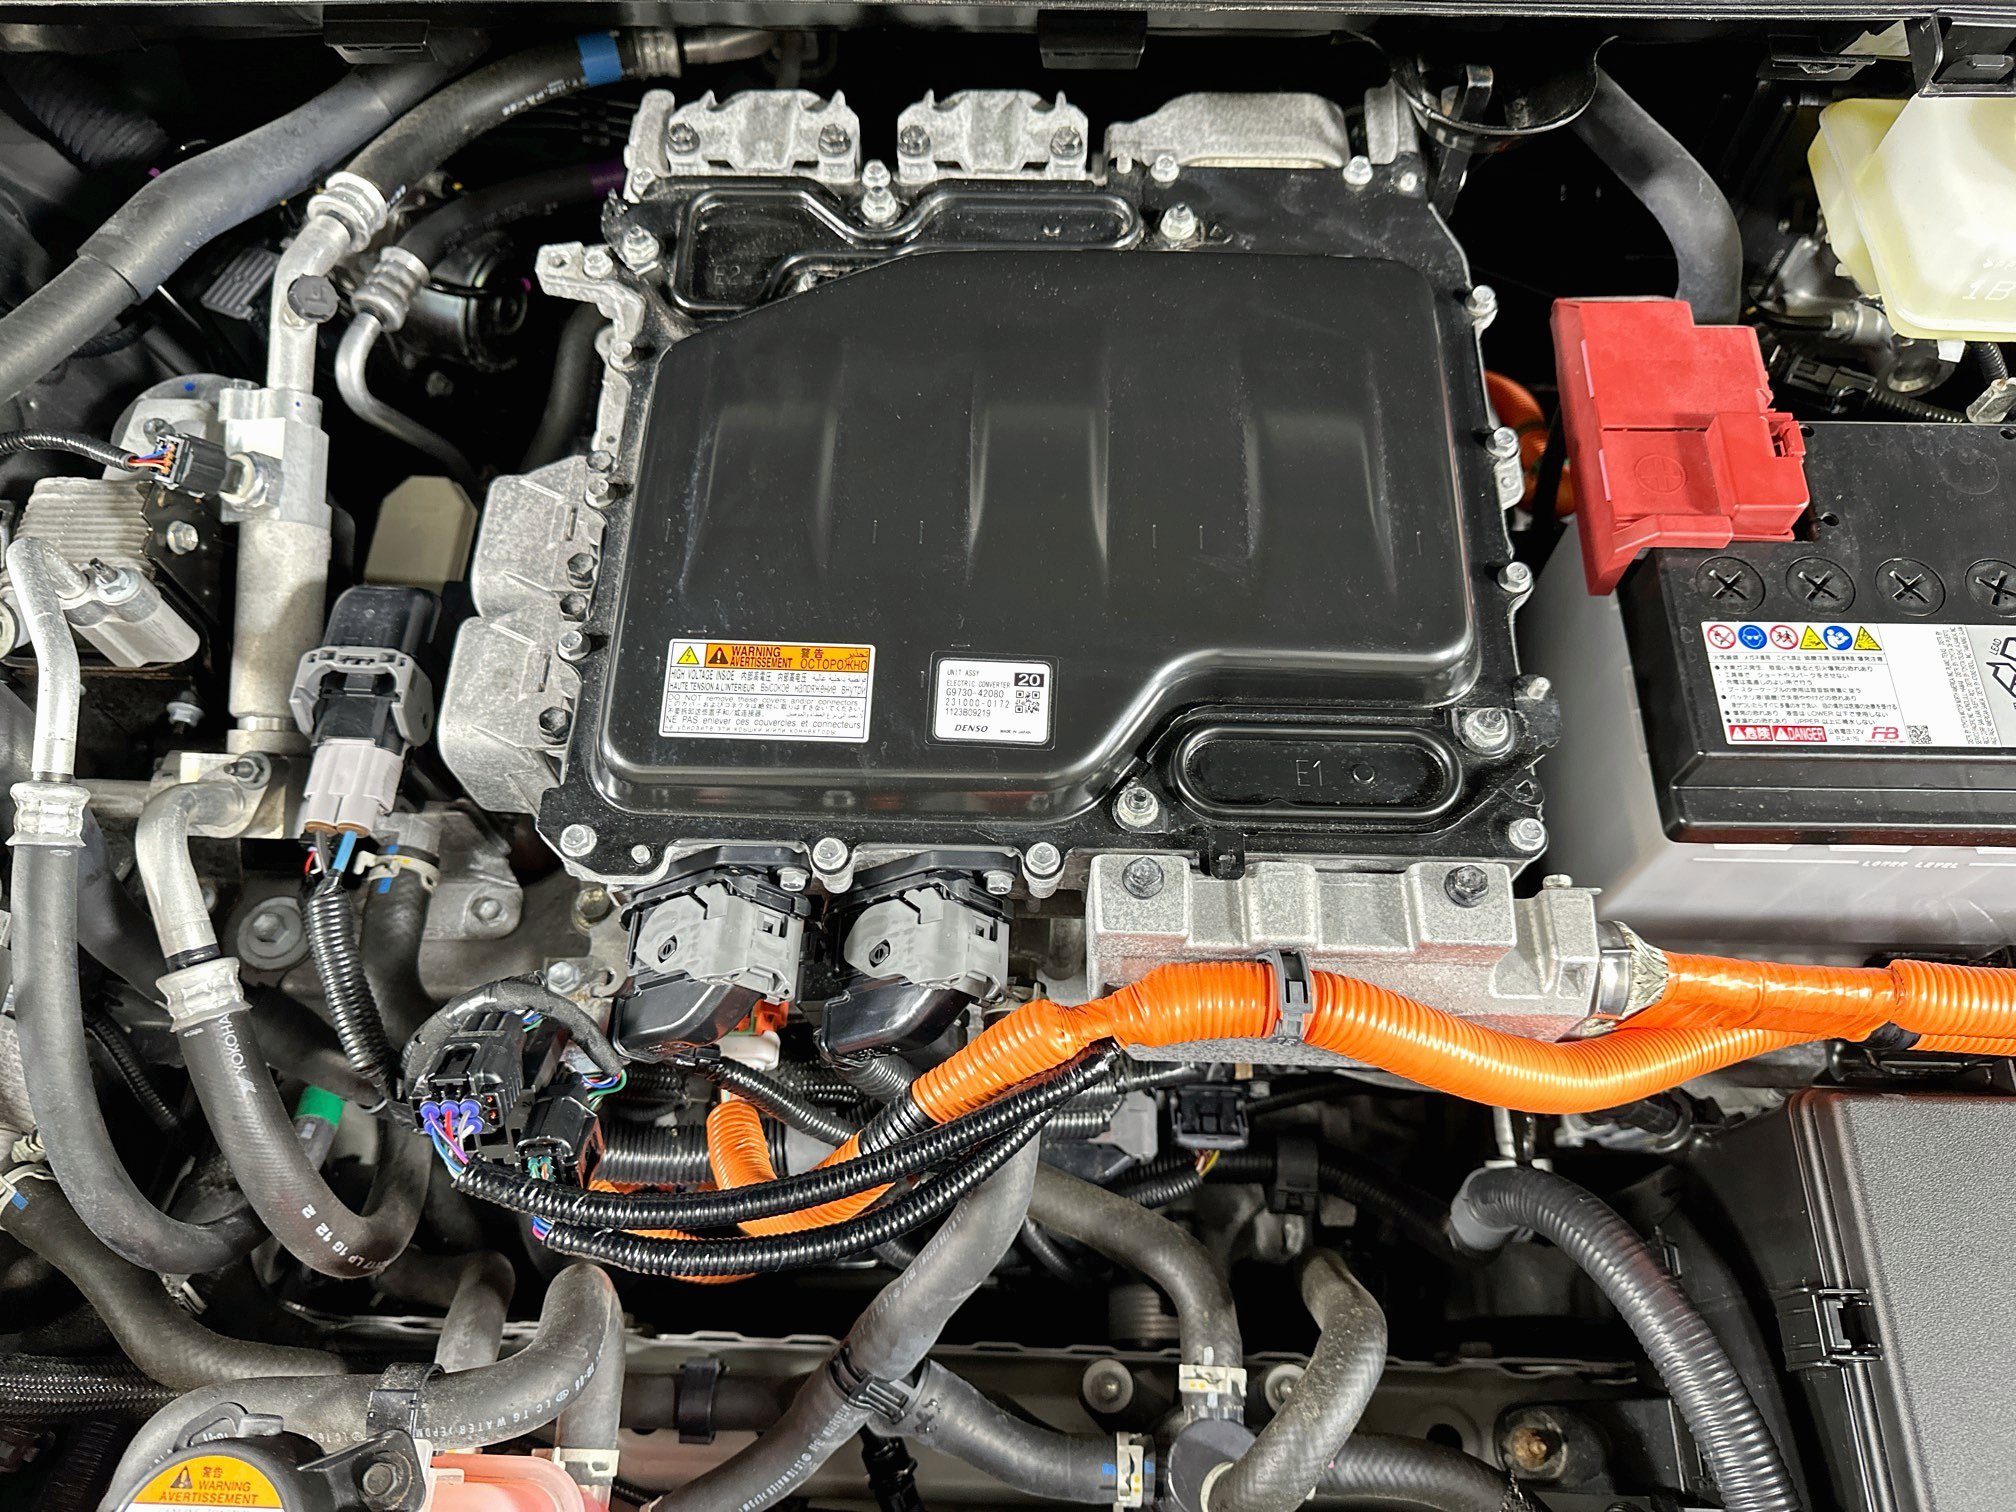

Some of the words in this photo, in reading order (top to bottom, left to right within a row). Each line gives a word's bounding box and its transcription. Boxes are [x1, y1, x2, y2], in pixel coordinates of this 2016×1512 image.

[731, 646, 781, 658] WARNING
[800, 647, 824, 659] 警告
[1989, 637, 2002, 656] LEAD
[730, 656, 793, 669] AVERTISSEMENT
[800, 658, 867, 671] ОСТОРОЖНО
[671, 669, 685, 680] HIGH
[688, 669, 713, 680] VOLTAGE
[715, 670, 735, 681] INSIDE
[1017, 673, 1041, 687] 20
[670, 682, 688, 691] HAUTE
[690, 682, 714, 691] TENSION
[946, 680, 975, 688] ELECTRIC
[978, 681, 1011, 689] CONVERTER
[685, 694, 702, 702] NOT
[818, 698, 858, 706] connectors
[946, 688, 1005, 699] G9730-42080
[945, 698, 1010, 709] 231000-0172
[666, 715, 678, 724] NE
[682, 715, 698, 724] PAS
[703, 717, 731, 725] enlever
[736, 718, 750, 726] ces
[754, 718, 796, 727] couvercles
[813, 720, 861, 729] connecteurs
[954, 724, 989, 733] DENSO
[1744, 727, 1772, 740] 危険
[1787, 727, 1826, 741] DANGER
[1871, 727, 1900, 739] FB
[1295, 759, 1323, 787] E1
[301, 1203, 317, 1219] 2
[315, 1222, 334, 1242] 12
[332, 1240, 349, 1257] 1G
[459, 1416, 507, 1436] WATER
[201, 1466, 223, 1479] 警告
[198, 1481, 251, 1492] WARNING
[766, 1475, 790, 1496] WATER
[159, 1491, 258, 1504] AVERTISSEMENT
